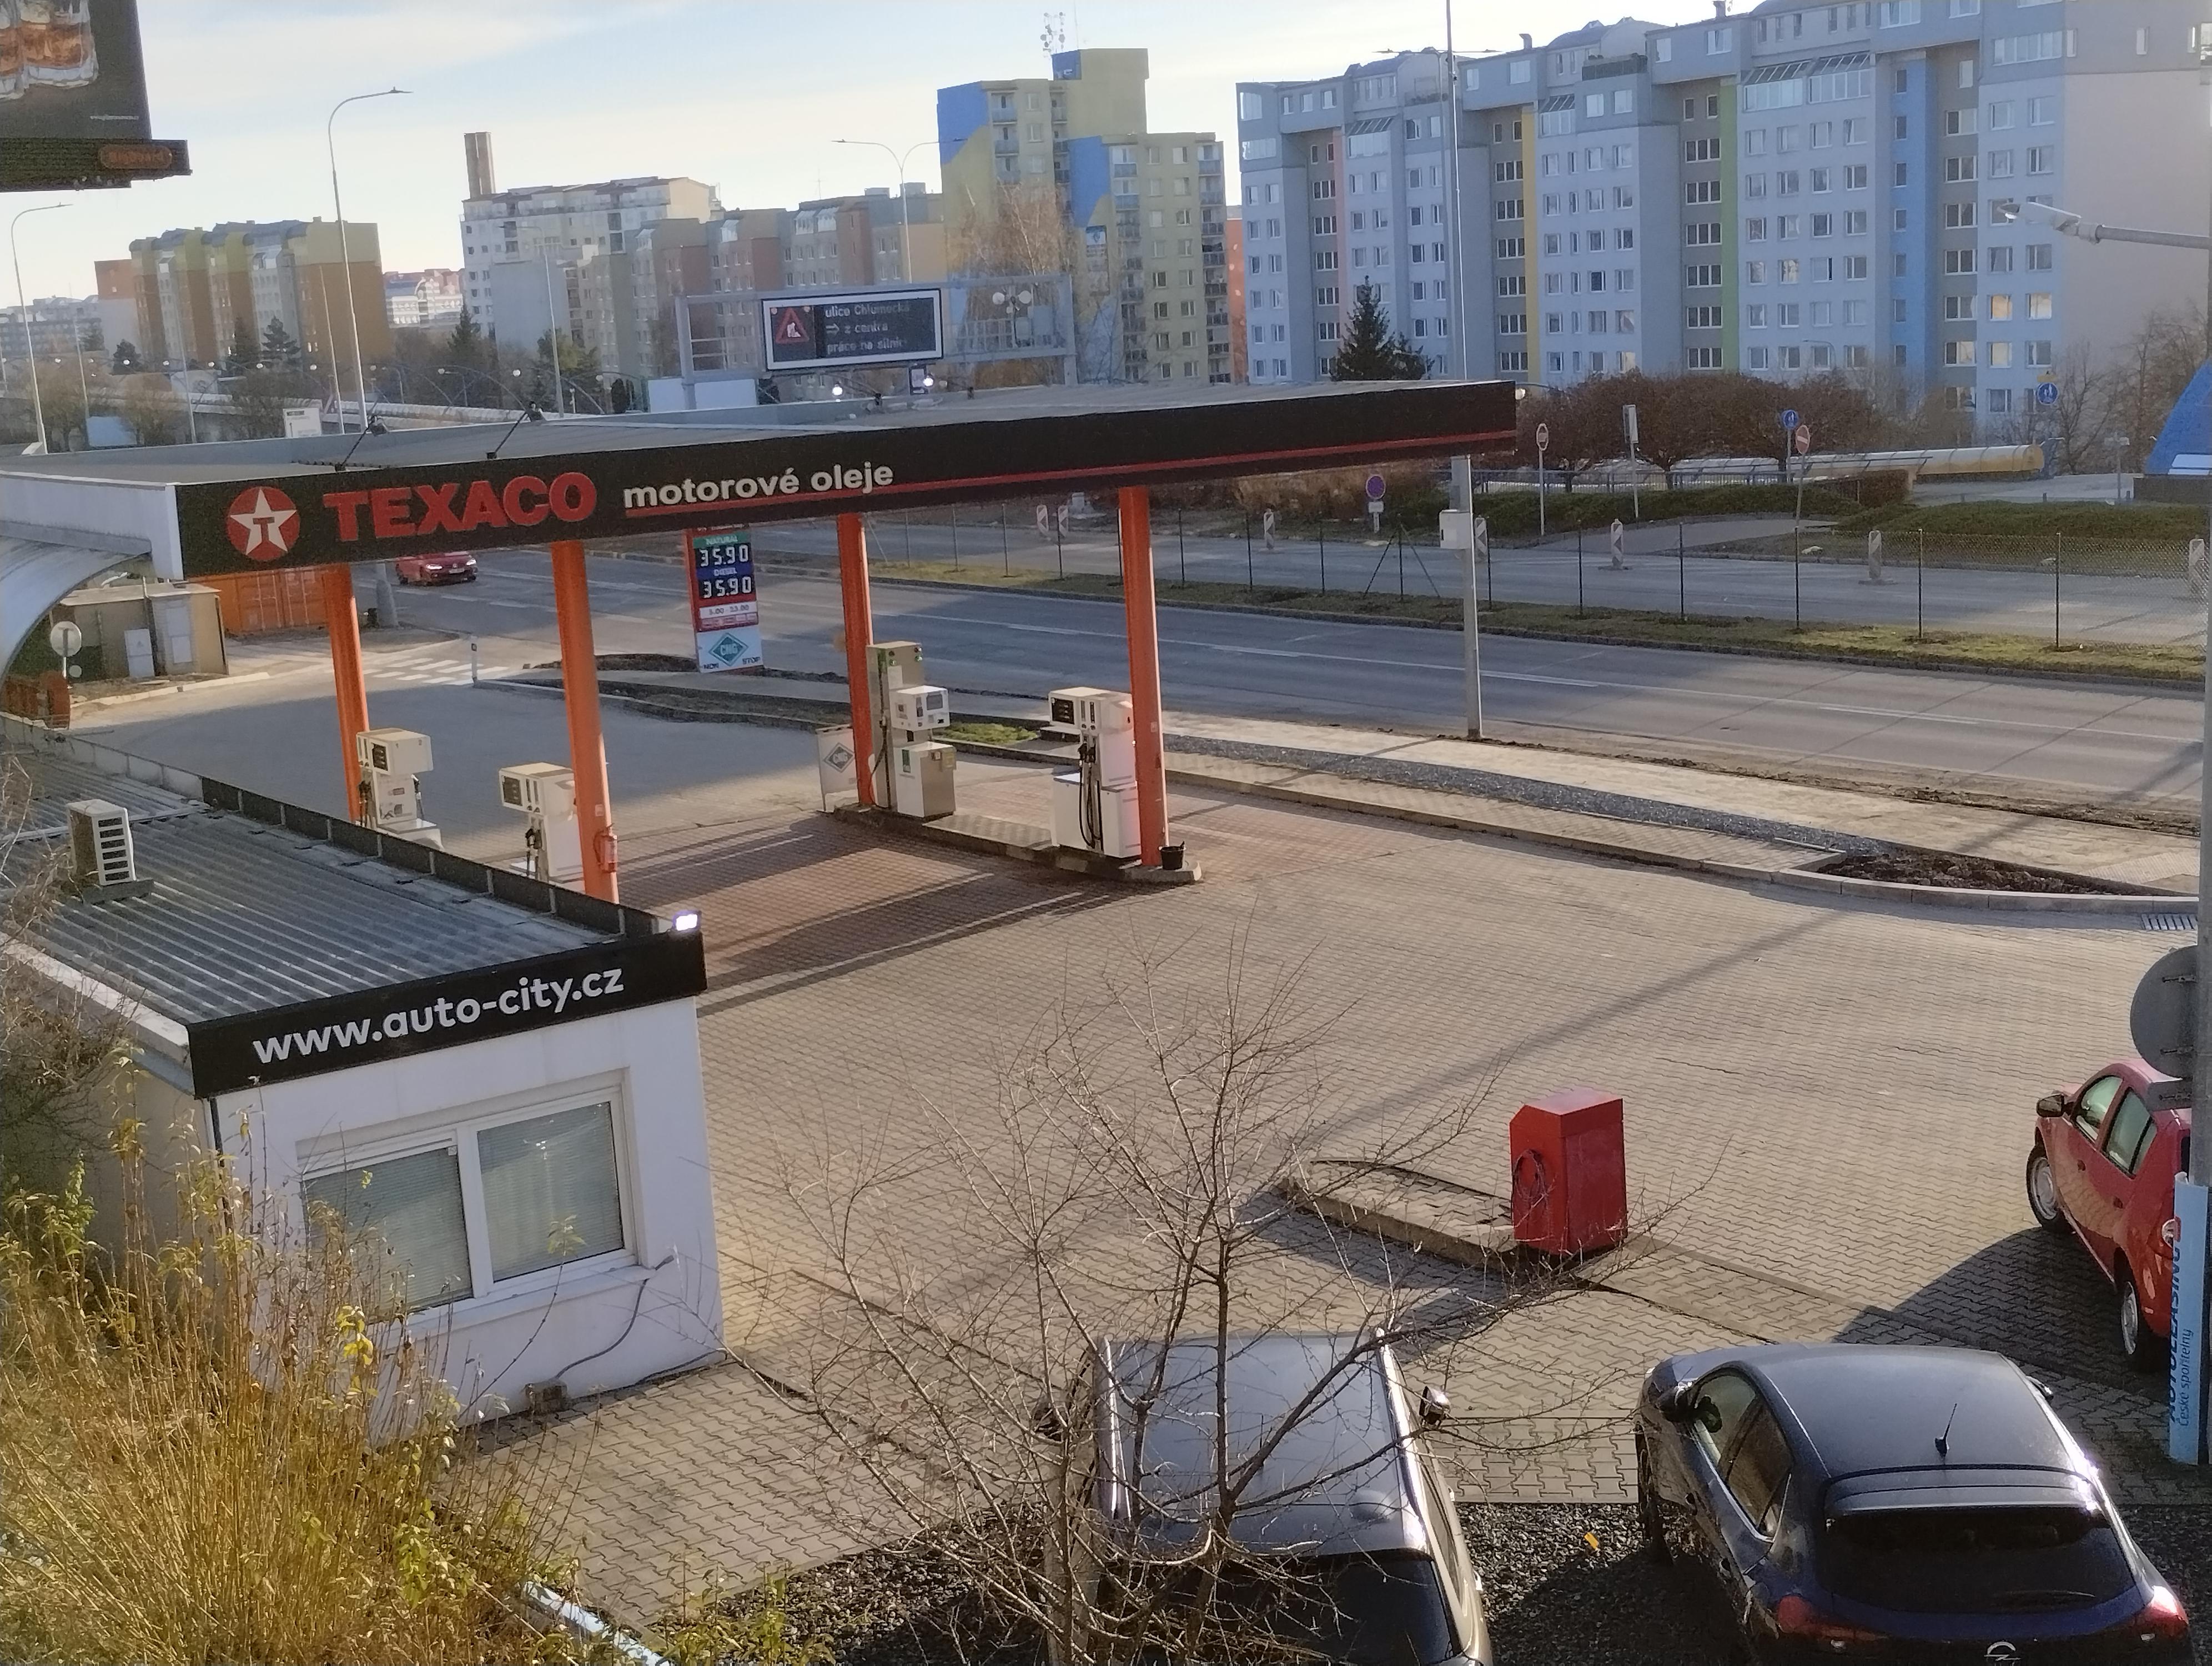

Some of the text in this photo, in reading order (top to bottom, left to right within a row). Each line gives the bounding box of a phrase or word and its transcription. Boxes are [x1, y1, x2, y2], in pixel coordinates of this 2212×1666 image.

[323, 471, 597, 541] TEXACO
[624, 461, 894, 509] motorové oleje
[700, 544, 749, 566] 35.90
[703, 576, 752, 598] 35.90
[253, 968, 625, 1064] www.auto-city.cz
